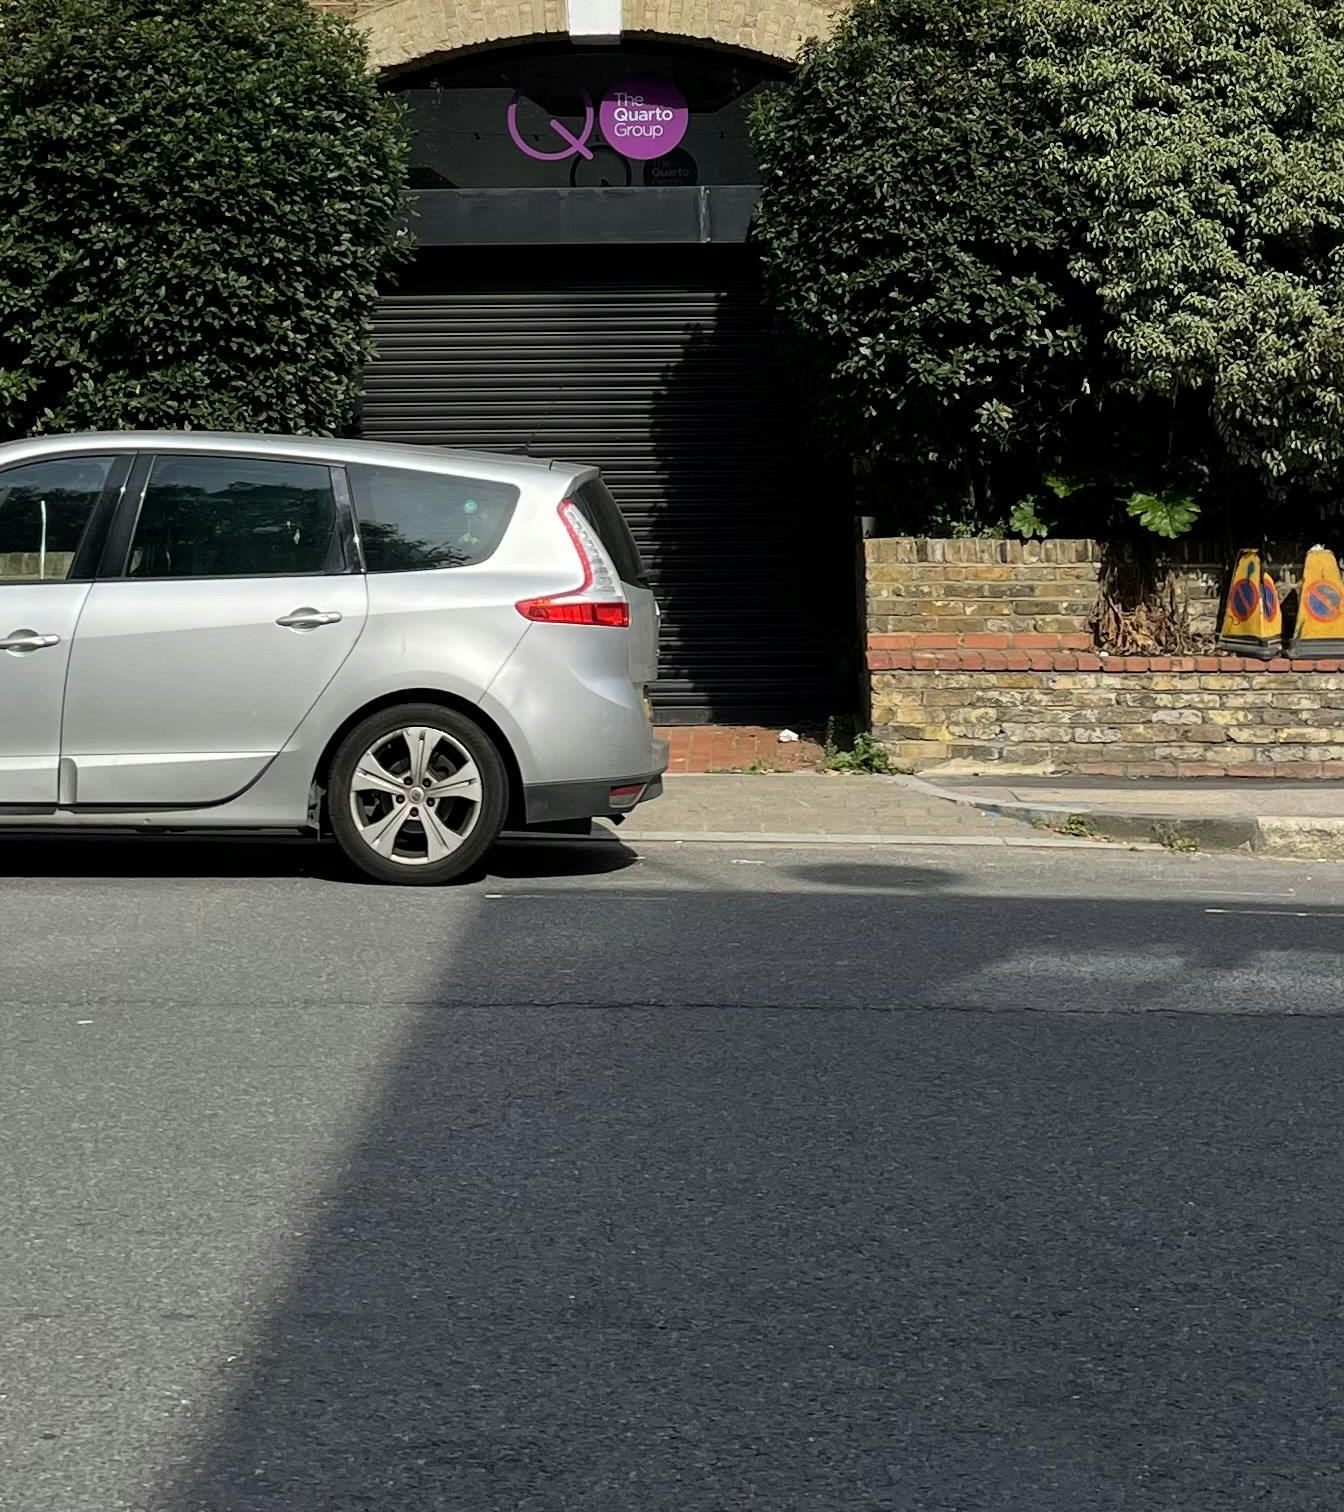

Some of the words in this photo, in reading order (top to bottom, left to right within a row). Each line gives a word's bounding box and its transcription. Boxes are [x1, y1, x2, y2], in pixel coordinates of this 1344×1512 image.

[614, 92, 644, 106] The
[614, 106, 673, 122] Quarto
[614, 122, 664, 139] Group
